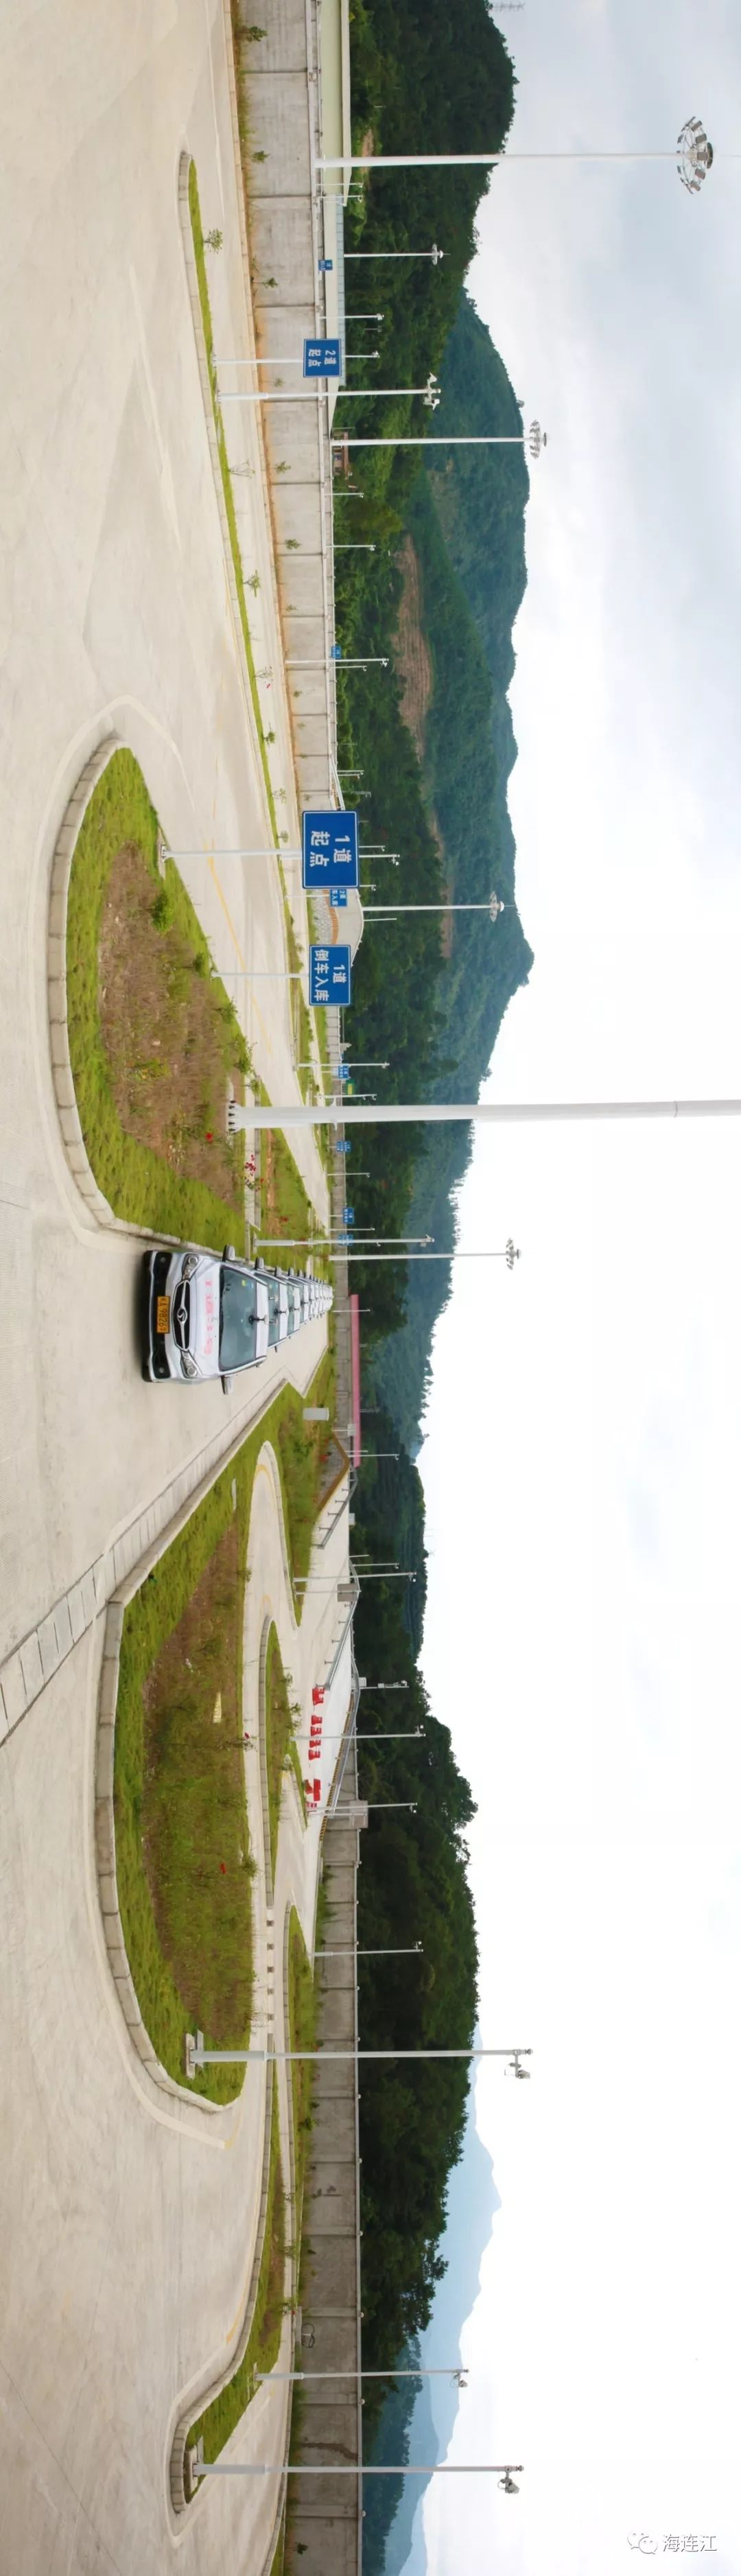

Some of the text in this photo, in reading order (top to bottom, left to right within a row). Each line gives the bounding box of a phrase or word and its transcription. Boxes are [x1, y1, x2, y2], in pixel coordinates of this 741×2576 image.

[308, 349, 322, 367] 起点
[325, 350, 336, 365] 2道
[309, 830, 330, 867] 起点
[333, 835, 352, 863] 1道
[314, 949, 329, 1001] 倒车入库
[333, 964, 346, 983] 1道
